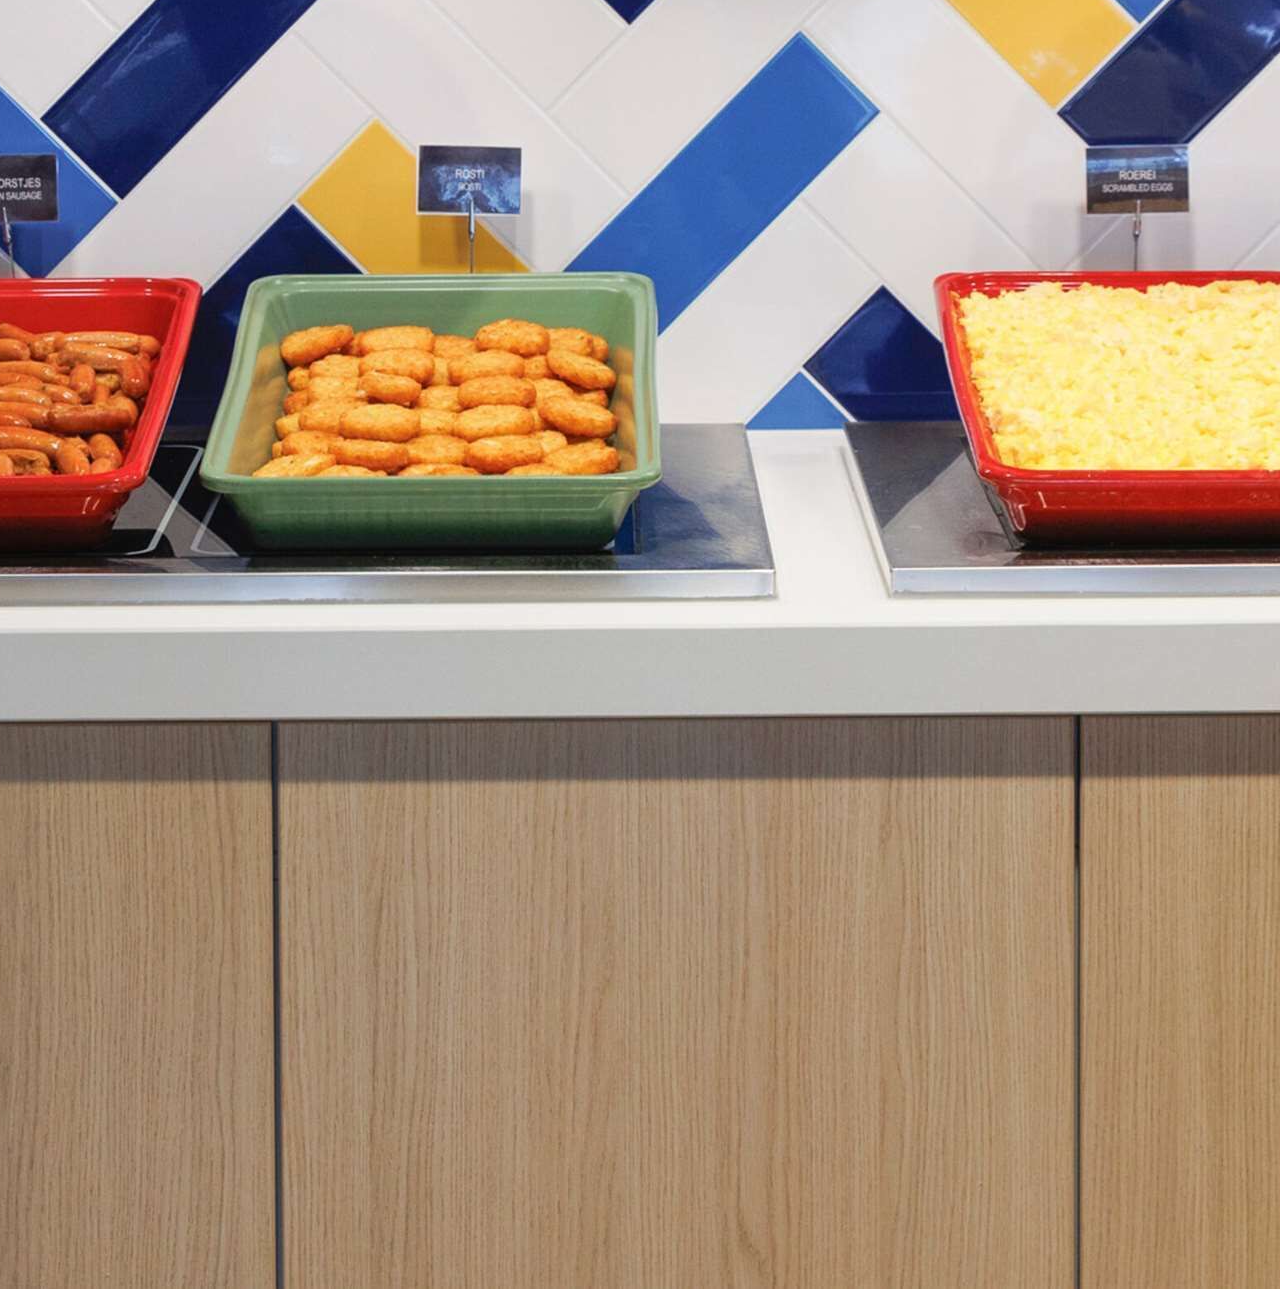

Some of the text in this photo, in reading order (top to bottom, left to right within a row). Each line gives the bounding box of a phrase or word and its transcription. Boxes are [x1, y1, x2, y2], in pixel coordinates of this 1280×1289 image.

[1119, 170, 1156, 180] ROEREI
[1102, 183, 1150, 192] SCRAMBLED
[6, 191, 42, 200] SAUSAGE
